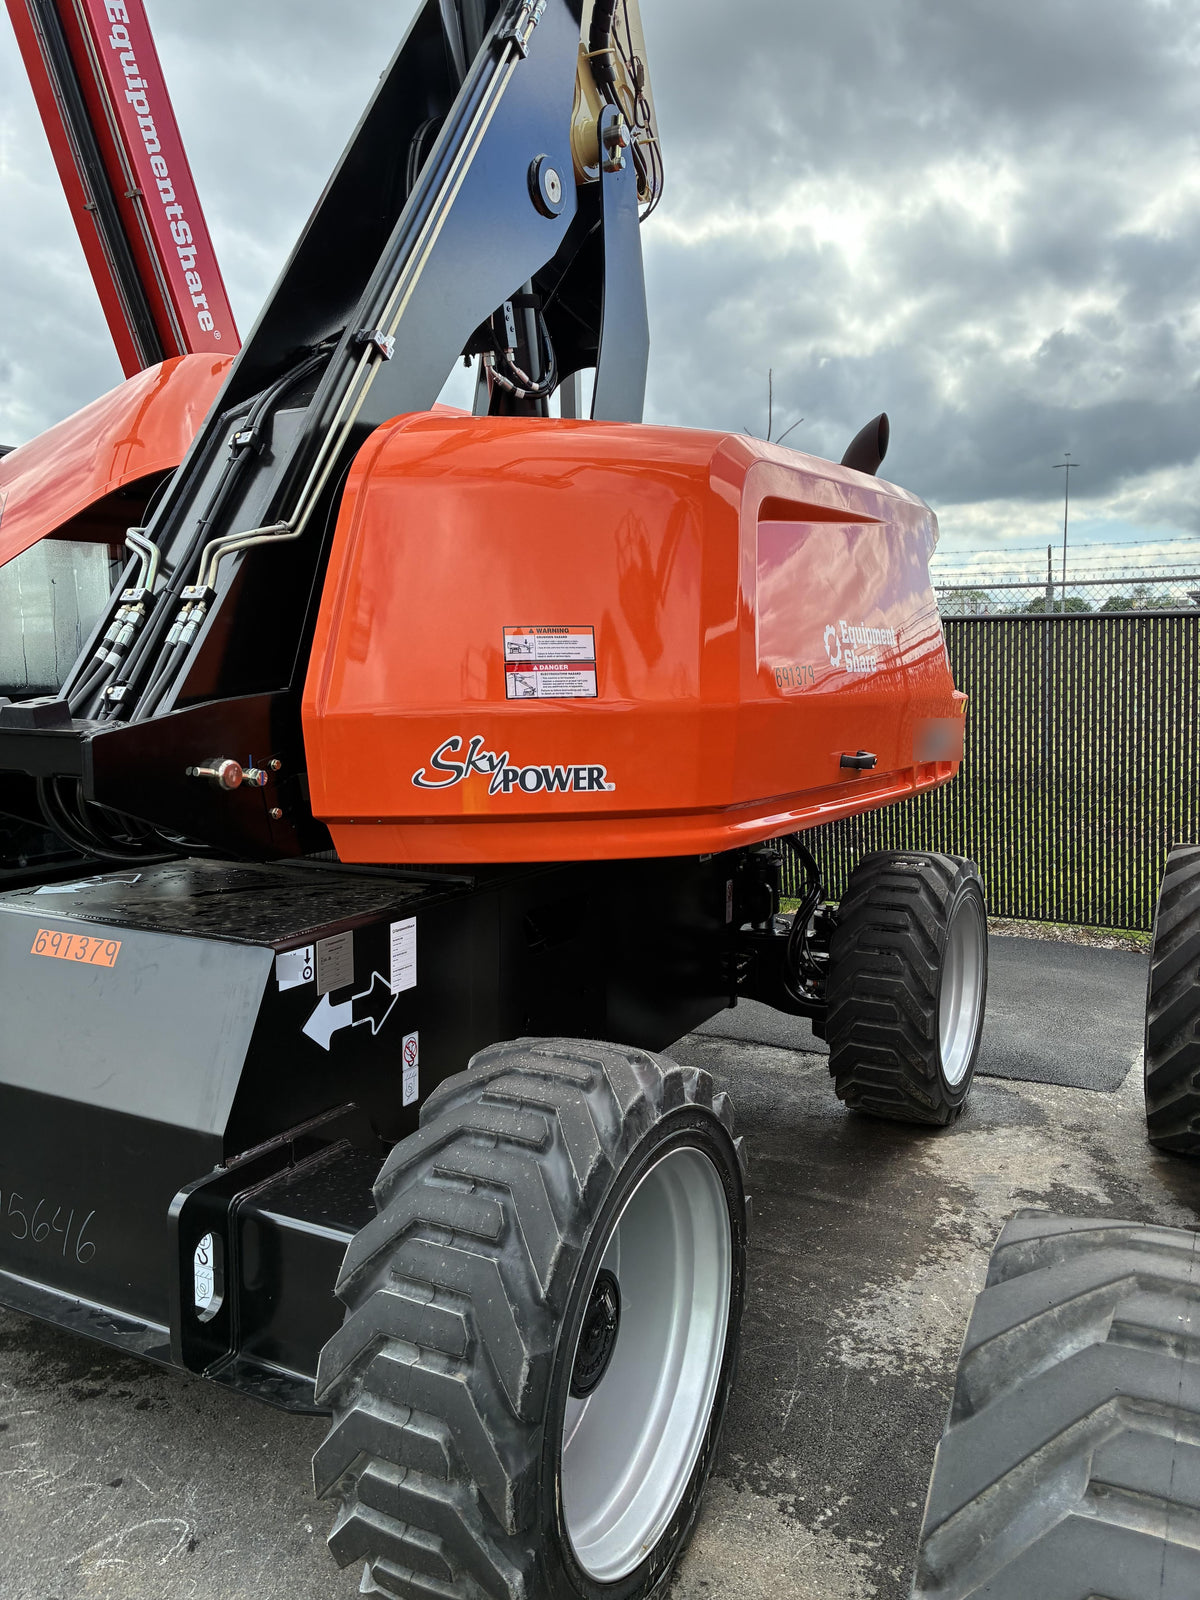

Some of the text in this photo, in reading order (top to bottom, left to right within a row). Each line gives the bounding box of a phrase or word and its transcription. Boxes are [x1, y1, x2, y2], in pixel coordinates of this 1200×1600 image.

[839, 620, 897, 648] Equipment
[844, 649, 878, 673] Share
[775, 665, 815, 688] 691379
[35, 930, 118, 966] 691379
[0, 1189, 96, 1264] 5646
